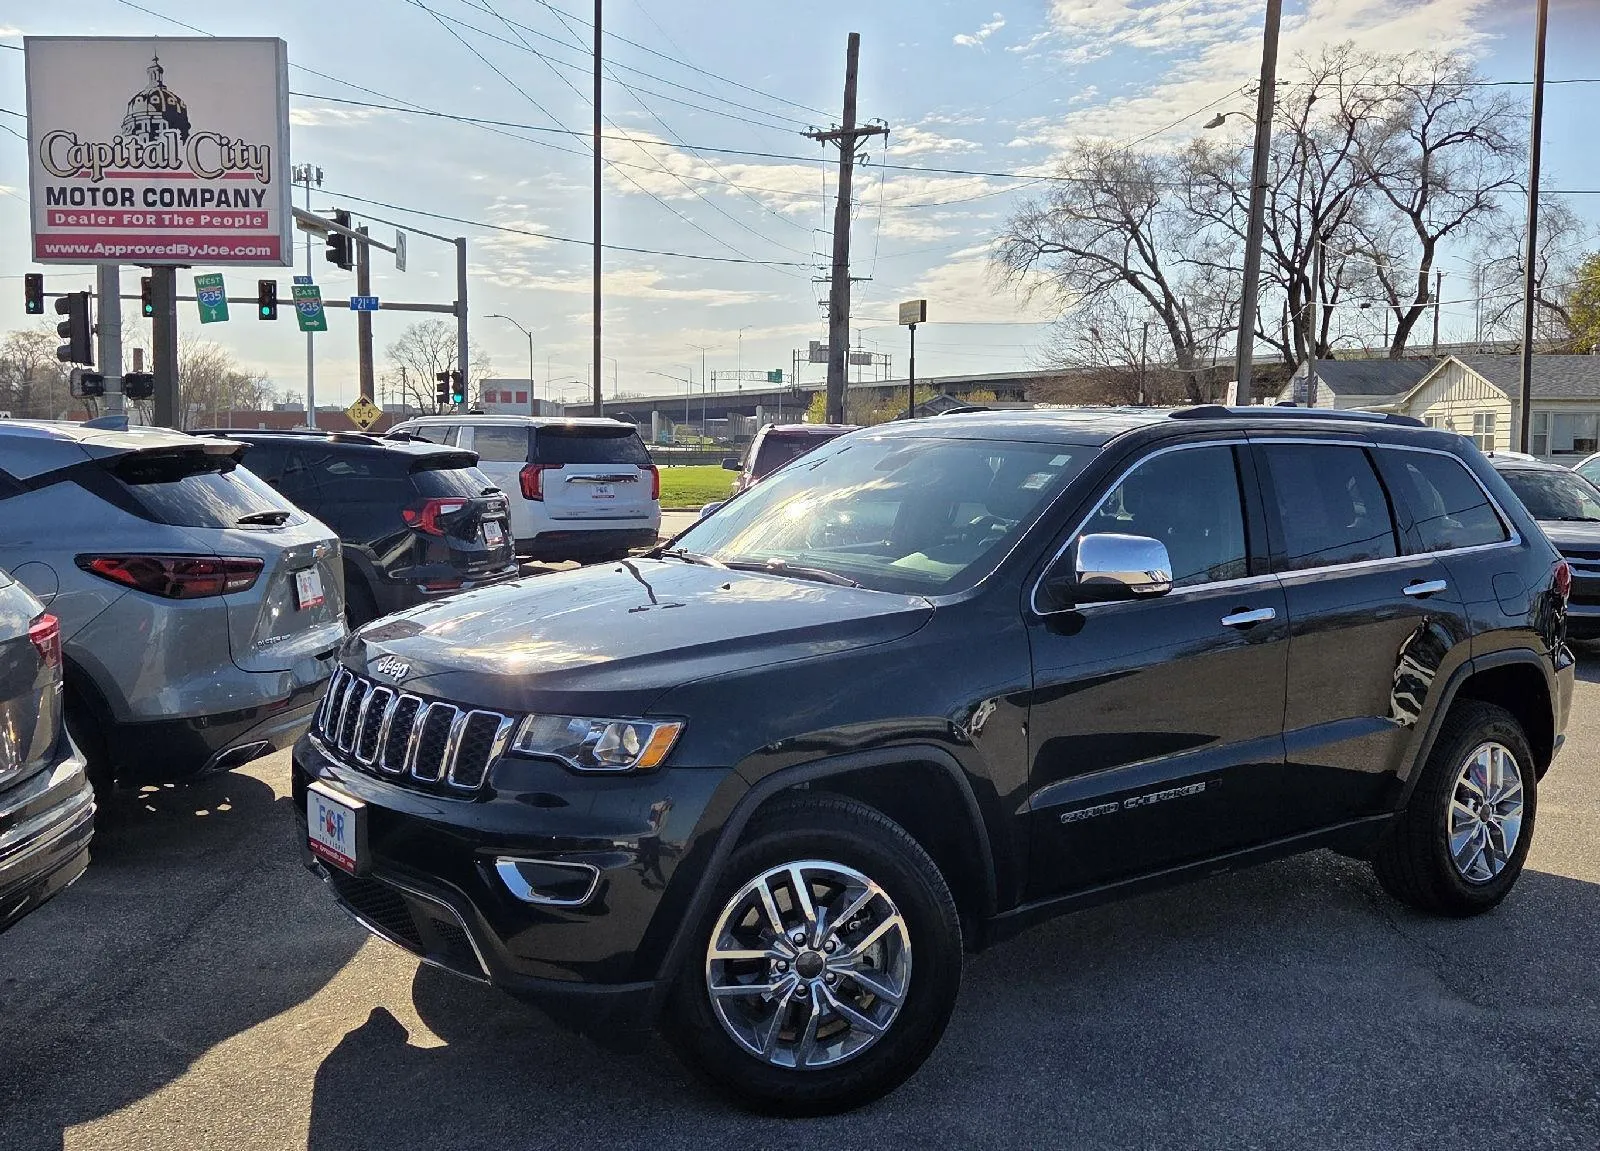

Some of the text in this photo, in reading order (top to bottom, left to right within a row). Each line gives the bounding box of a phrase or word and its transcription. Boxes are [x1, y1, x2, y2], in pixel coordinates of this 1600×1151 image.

[40, 130, 271, 184] Capital City
[46, 186, 267, 208] MOTOR COMPANY
[55, 213, 263, 228] Dealer FOR The People
[45, 243, 271, 257] www.ApprovedByJoe.com
[197, 276, 221, 286] WEST
[202, 290, 222, 302] 235
[294, 288, 317, 297] EAST
[300, 301, 320, 312] 235
[377, 655, 410, 682] Jeep
[1060, 801, 1120, 824] GRAND
